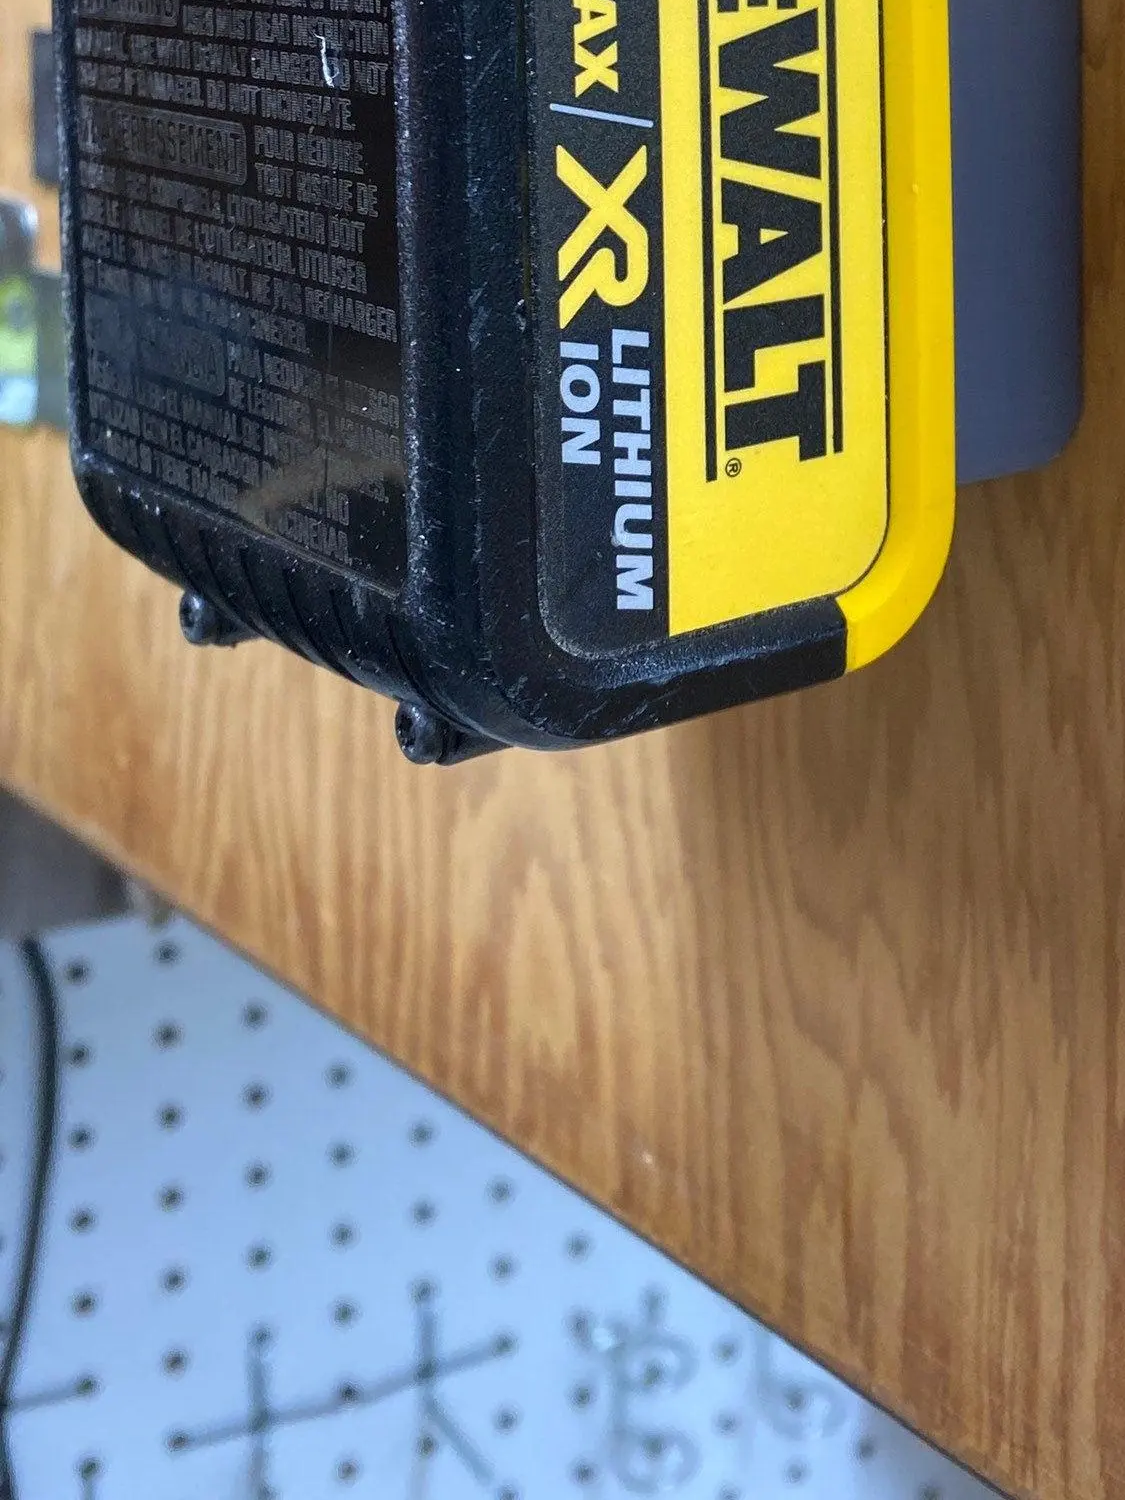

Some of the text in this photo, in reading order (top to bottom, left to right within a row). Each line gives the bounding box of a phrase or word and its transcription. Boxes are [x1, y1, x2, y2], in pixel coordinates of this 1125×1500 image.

[254, 10, 290, 45] READ
[227, 81, 259, 117] NOT
[254, 125, 294, 161] POUR
[555, 144, 648, 328] XR
[559, 340, 602, 466] ION
[610, 329, 654, 611] LITHIUM
